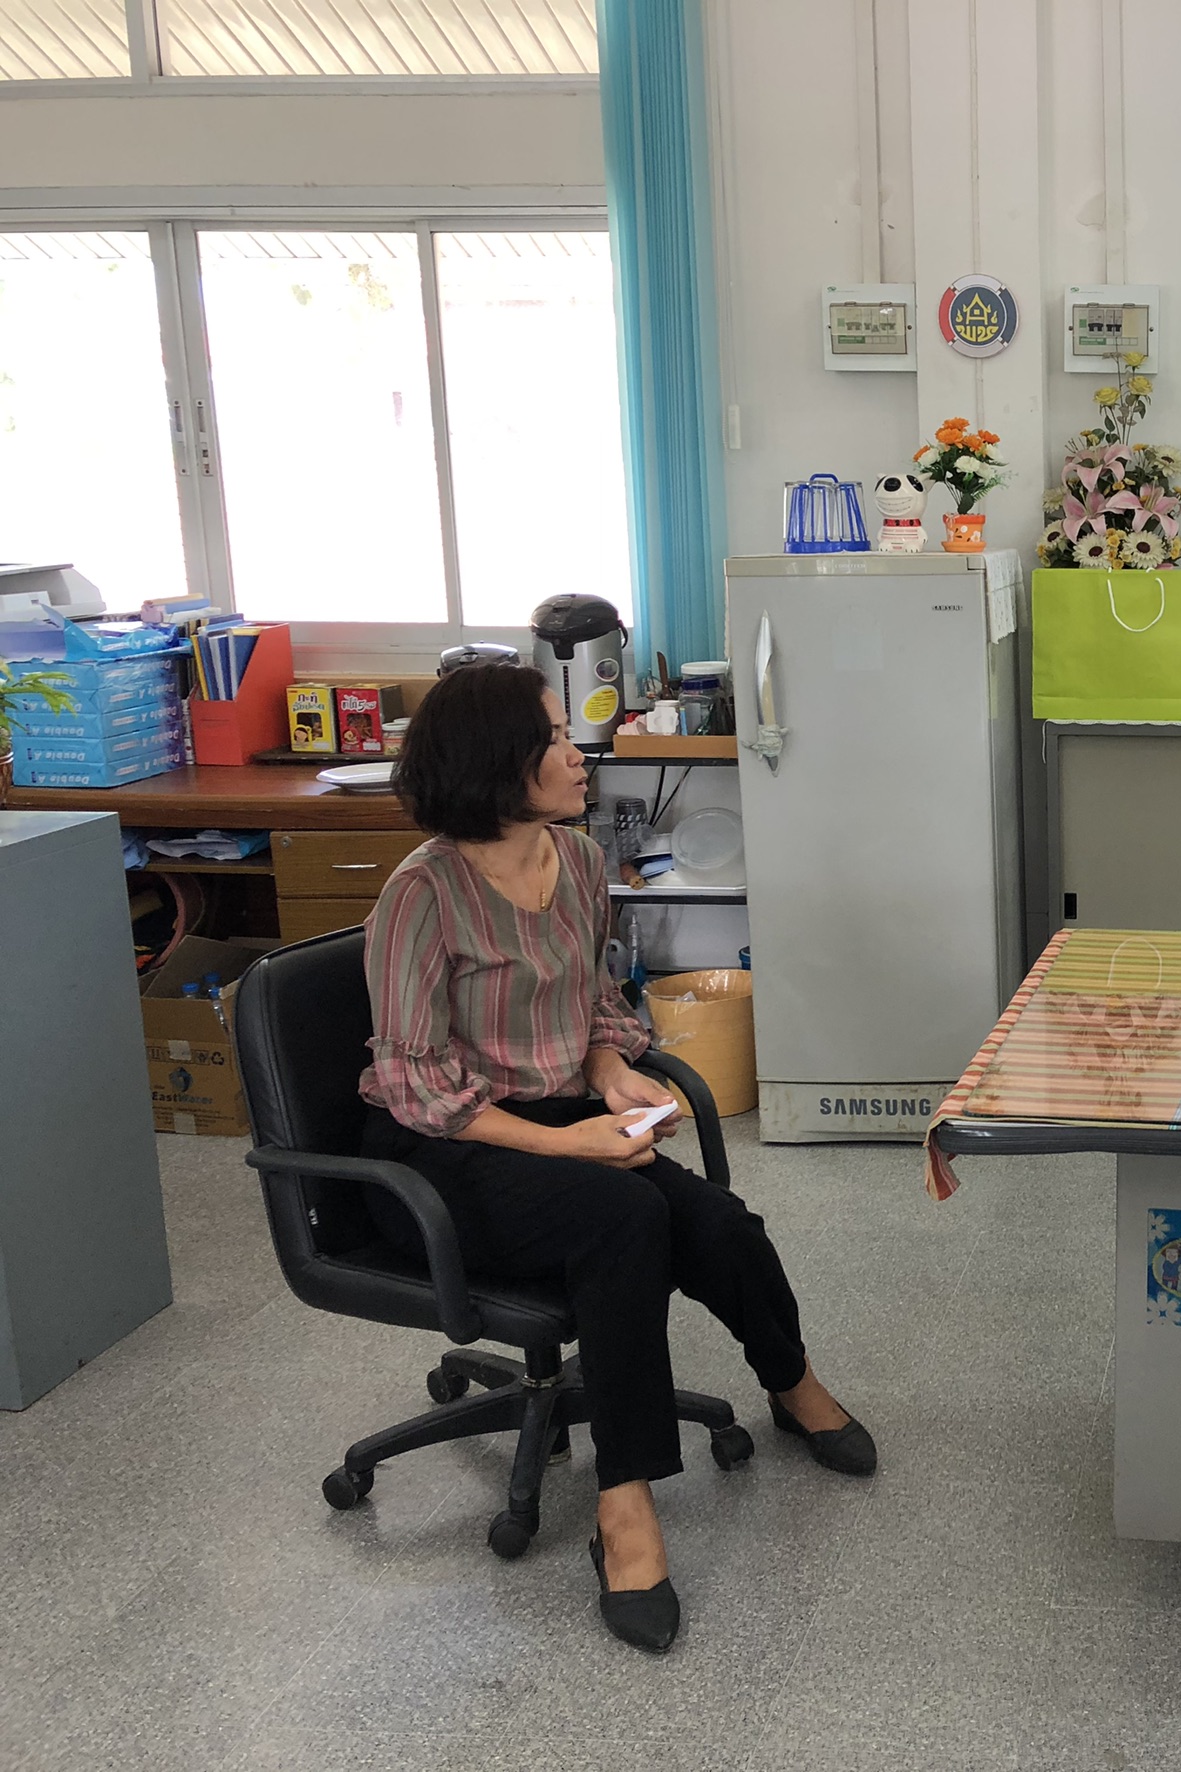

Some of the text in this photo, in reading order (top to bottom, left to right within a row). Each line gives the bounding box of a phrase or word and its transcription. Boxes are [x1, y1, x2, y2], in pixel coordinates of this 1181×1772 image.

[44, 727, 84, 737] Double
[33, 751, 85, 761] Double A
[37, 774, 90, 785] Double A
[820, 1097, 931, 1116] SAMSUNG
